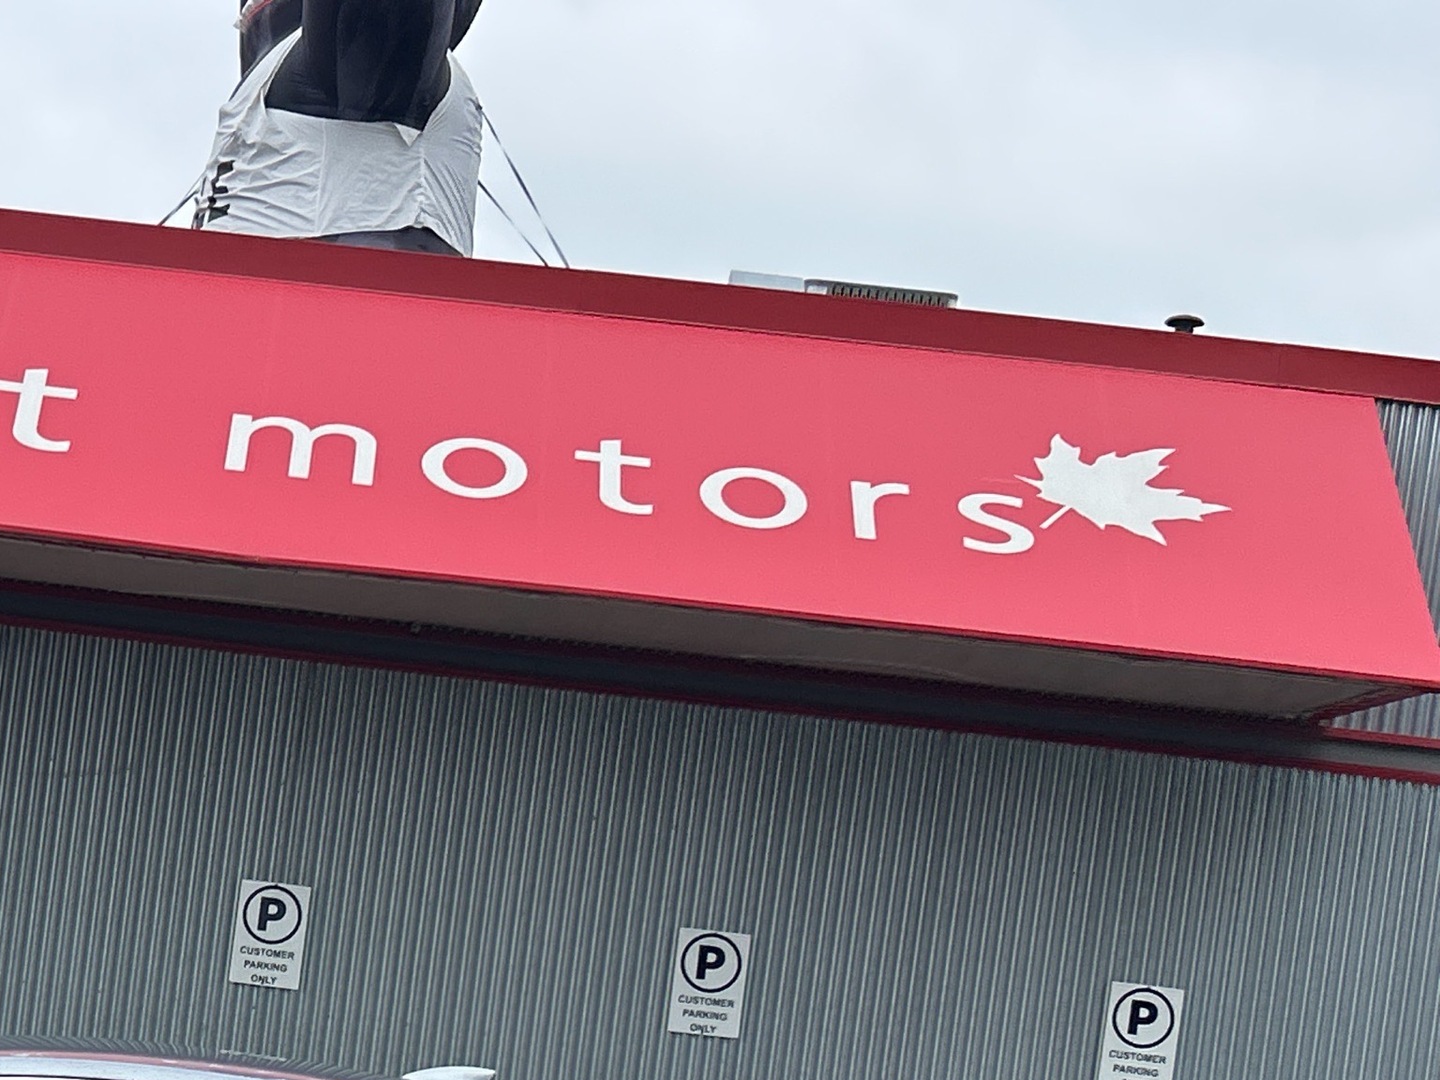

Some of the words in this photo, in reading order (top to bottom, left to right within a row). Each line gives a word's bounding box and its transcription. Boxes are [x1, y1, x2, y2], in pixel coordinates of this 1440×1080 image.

[222, 412, 1036, 555] motors
[257, 896, 286, 931] P
[240, 945, 295, 960] CUSTOMER
[243, 959, 287, 973] PARKING
[695, 944, 725, 980] P
[250, 973, 277, 985] ONLY
[677, 994, 735, 1008] CUSTOMER
[682, 1008, 727, 1021] PARKING
[1127, 999, 1158, 1035] P
[689, 1023, 717, 1034] ONLY
[1108, 1049, 1167, 1064] CUSTOMER
[1112, 1064, 1159, 1077] PARKING
